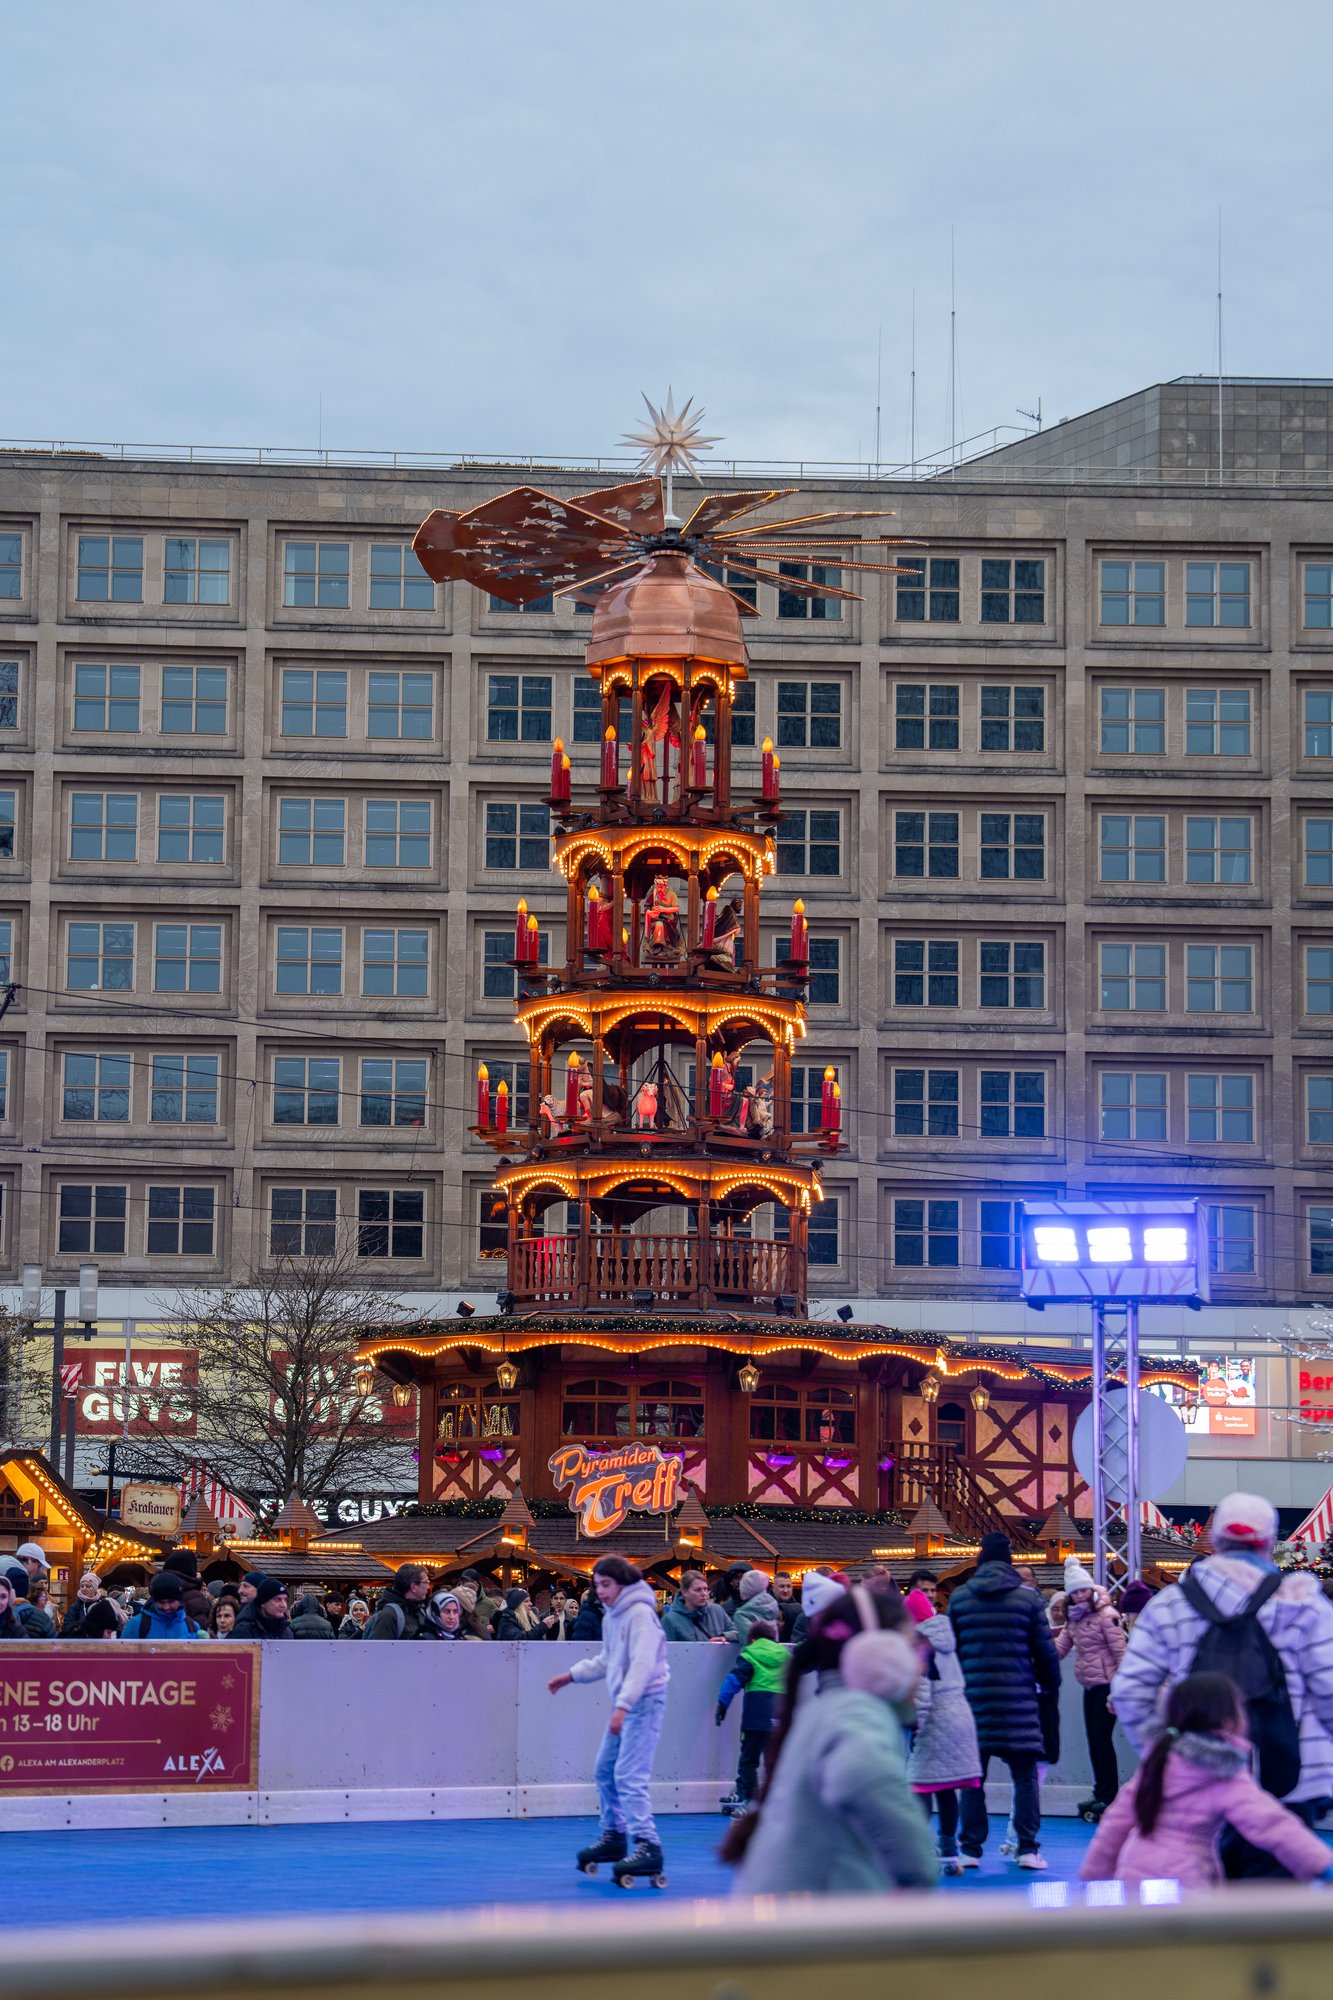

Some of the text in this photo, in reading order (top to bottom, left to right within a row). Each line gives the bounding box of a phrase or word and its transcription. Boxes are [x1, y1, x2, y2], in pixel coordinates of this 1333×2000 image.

[94, 1361, 183, 1388] FIVE
[82, 1393, 193, 1422] GUYS
[553, 1447, 657, 1483] Pyramiden
[127, 1499, 175, 1516] Krakauer
[575, 1459, 678, 1533] Treff
[0, 1679, 197, 1707] NE SONNTAGE
[67, 1713, 100, 1732] Uhr
[18, 1757, 125, 1767] ALEXA AM ALEXANDERPLATZ
[163, 1746, 226, 1783] ALEXA
